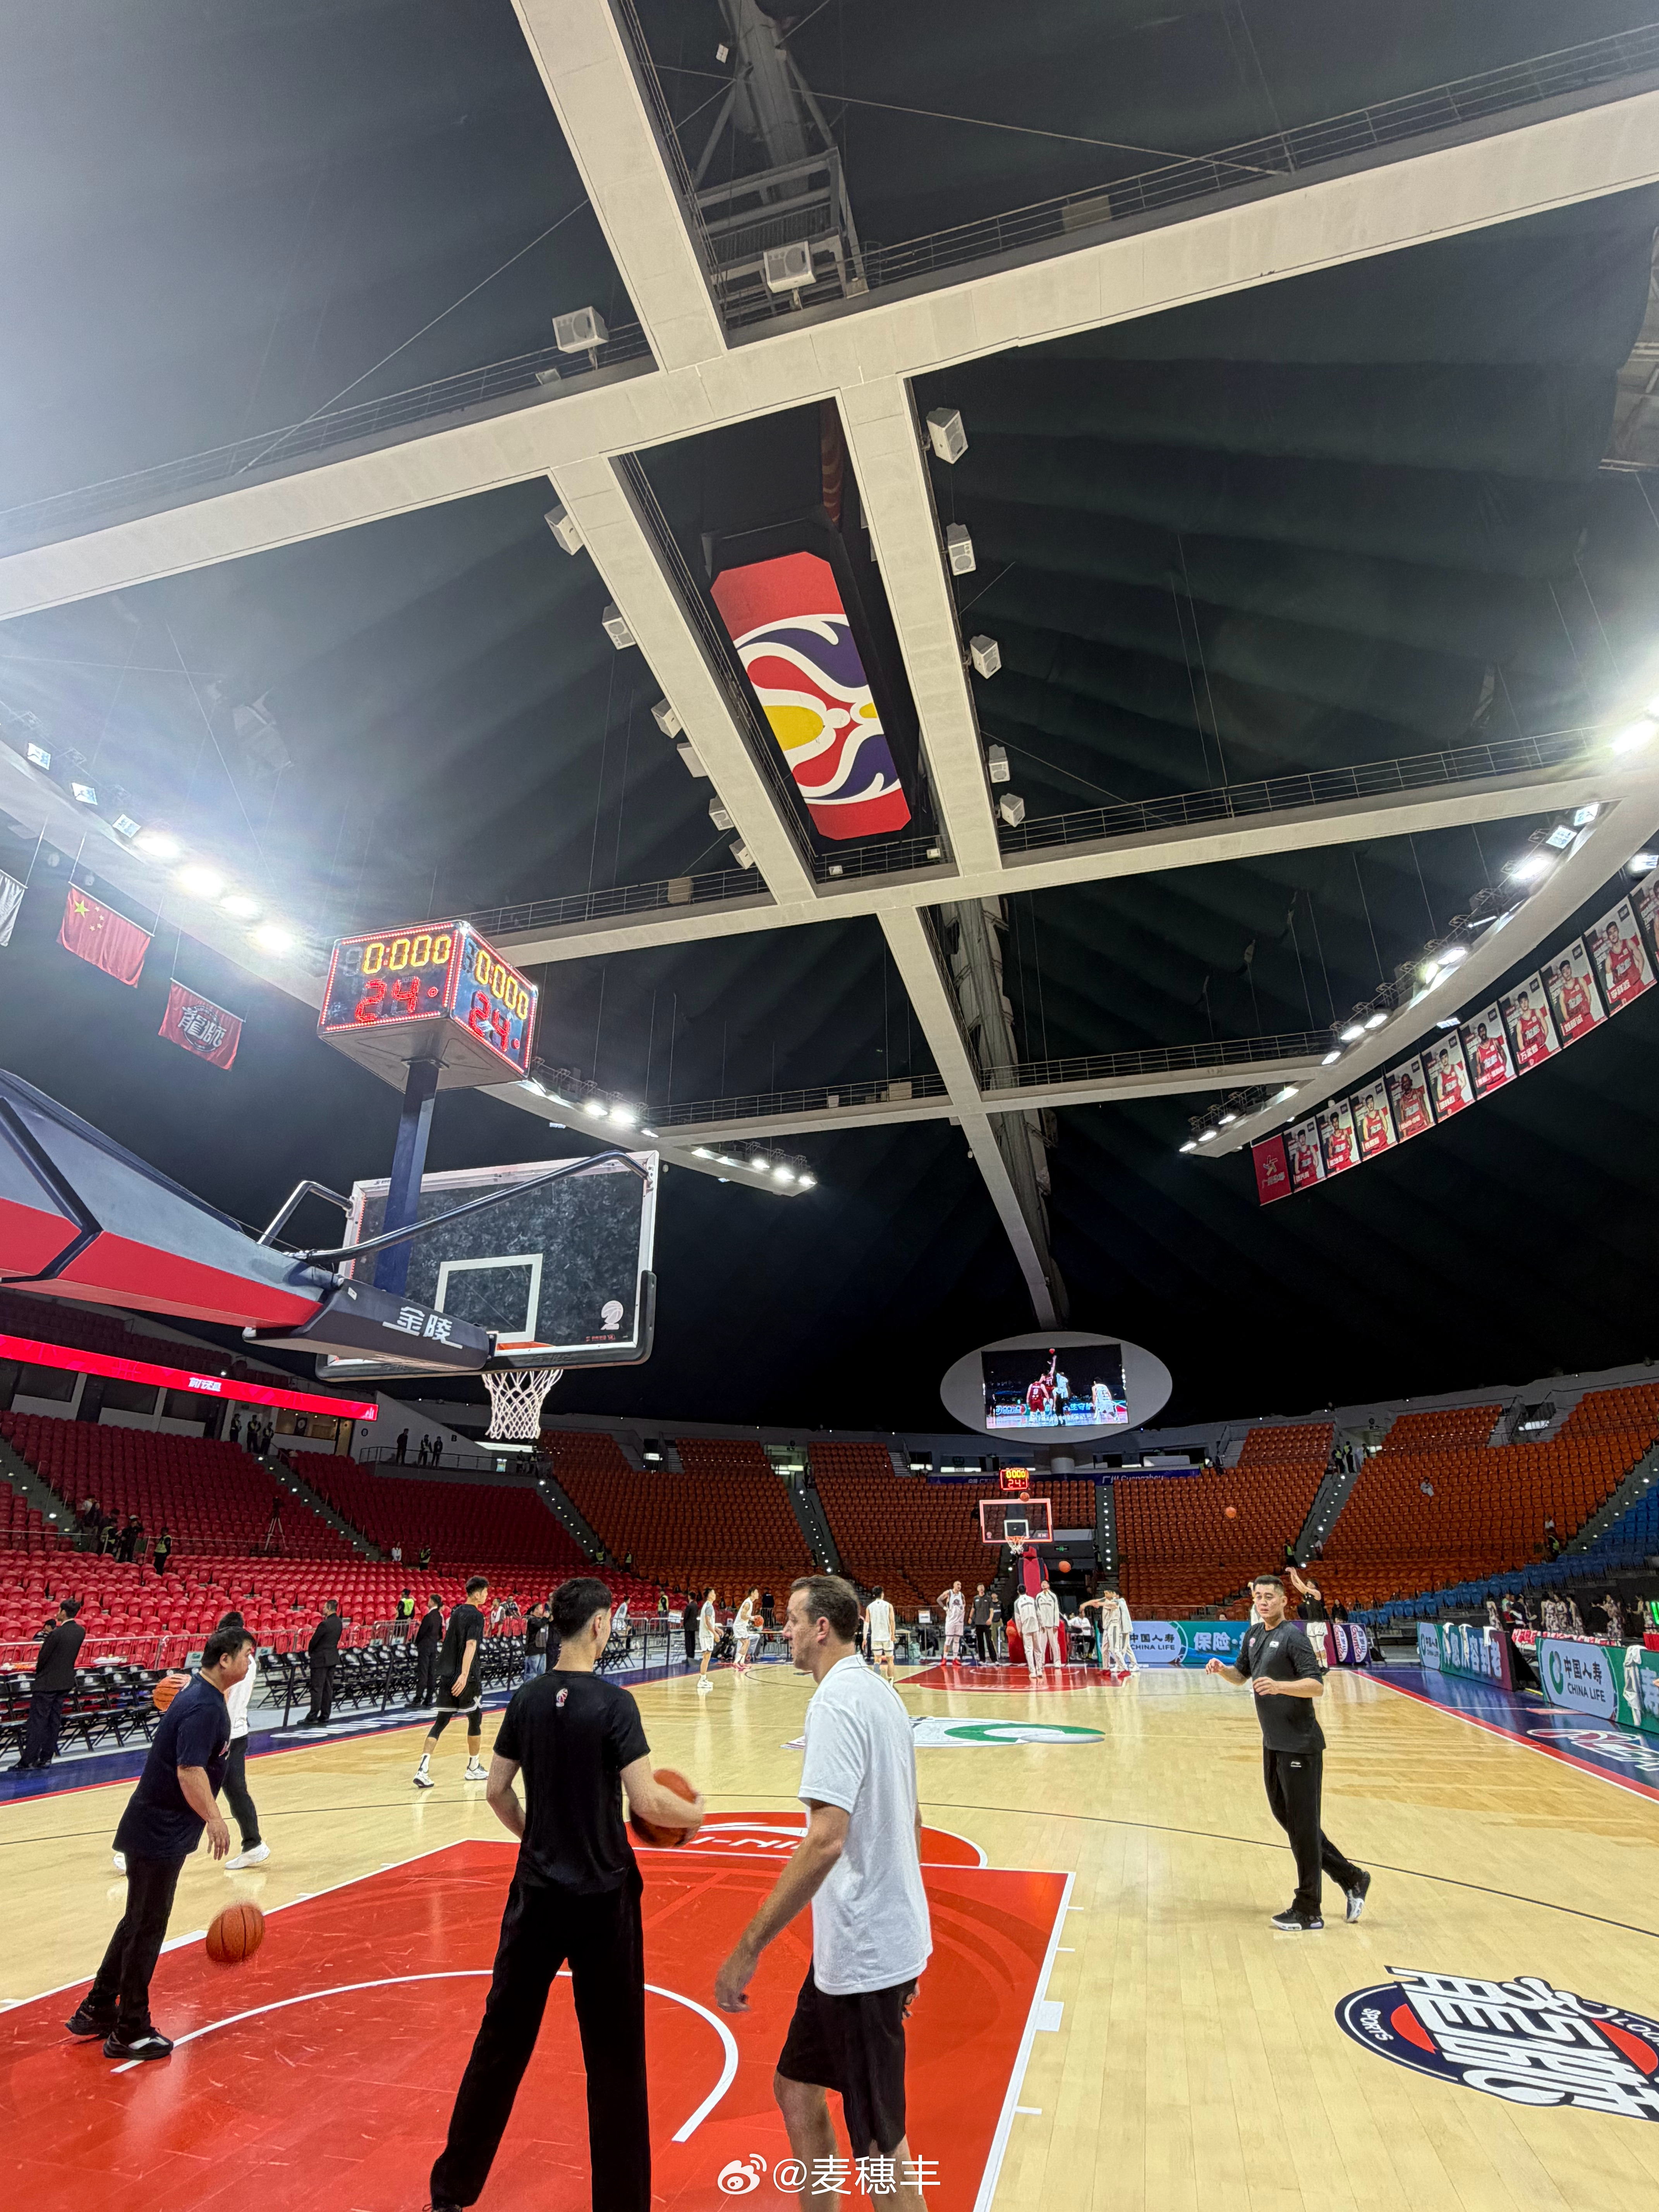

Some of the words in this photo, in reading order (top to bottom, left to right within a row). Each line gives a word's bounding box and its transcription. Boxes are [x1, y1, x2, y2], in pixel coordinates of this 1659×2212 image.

[382, 1306, 463, 1349] 金陵
[1129, 1633, 1175, 1644] 中国人寿
[1563, 1656, 1602, 1685] 中国人寿
[1567, 1682, 1589, 1698] CHINA
[1589, 1687, 1606, 1702] LIFE
[1360, 2008, 1394, 2040] SPORTS
